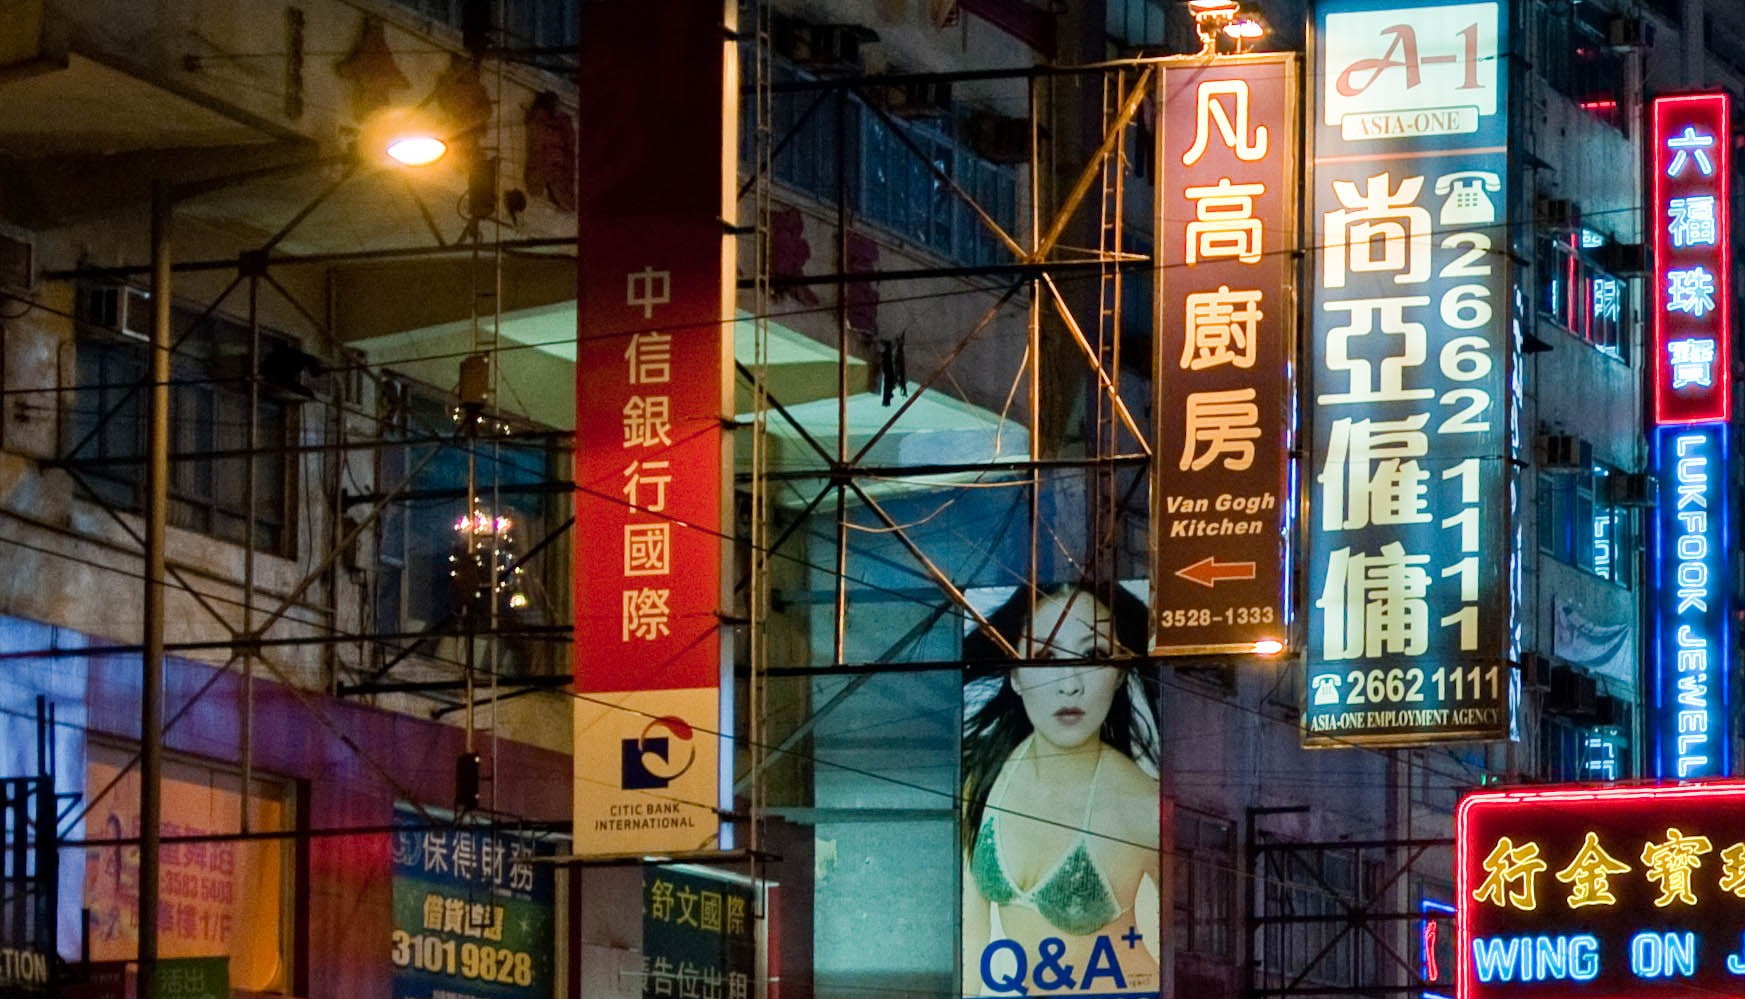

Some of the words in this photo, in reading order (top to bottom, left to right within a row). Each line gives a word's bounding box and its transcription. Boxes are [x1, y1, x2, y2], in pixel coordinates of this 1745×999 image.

[1334, 23, 1487, 97] A-1
[1360, 111, 1461, 135] ASIA-ONE
[1180, 79, 1268, 472] 凡高廚房
[1667, 127, 1717, 389] 六福珠寶
[1318, 172, 1435, 661] 尚亞僱傭
[621, 266, 672, 642] 中信銀行國際
[1166, 494, 1211, 513] Van
[1214, 492, 1275, 515] Gogh
[1169, 516, 1263, 538] Kitchen
[1676, 436, 1708, 614] LUKFOOK
[1162, 606, 1275, 628] 3528-1333
[1347, 668, 1424, 704] 2662
[1431, 666, 1498, 701] 1111
[1311, 711, 1365, 731] ASIA-ONE
[1367, 709, 1449, 729] EMPLOYMENT
[1452, 707, 1498, 726] AGENCY
[595, 815, 695, 831] INTERNATIONAL
[610, 804, 642, 817] CITIC
[646, 802, 680, 814] BANK
[424, 830, 533, 891] 保得財務
[643, 880, 746, 934] 舒文國際
[392, 929, 456, 975] 3101
[461, 943, 532, 986] 9828
[1474, 933, 1598, 981] WING
[1632, 932, 1695, 977] ON
